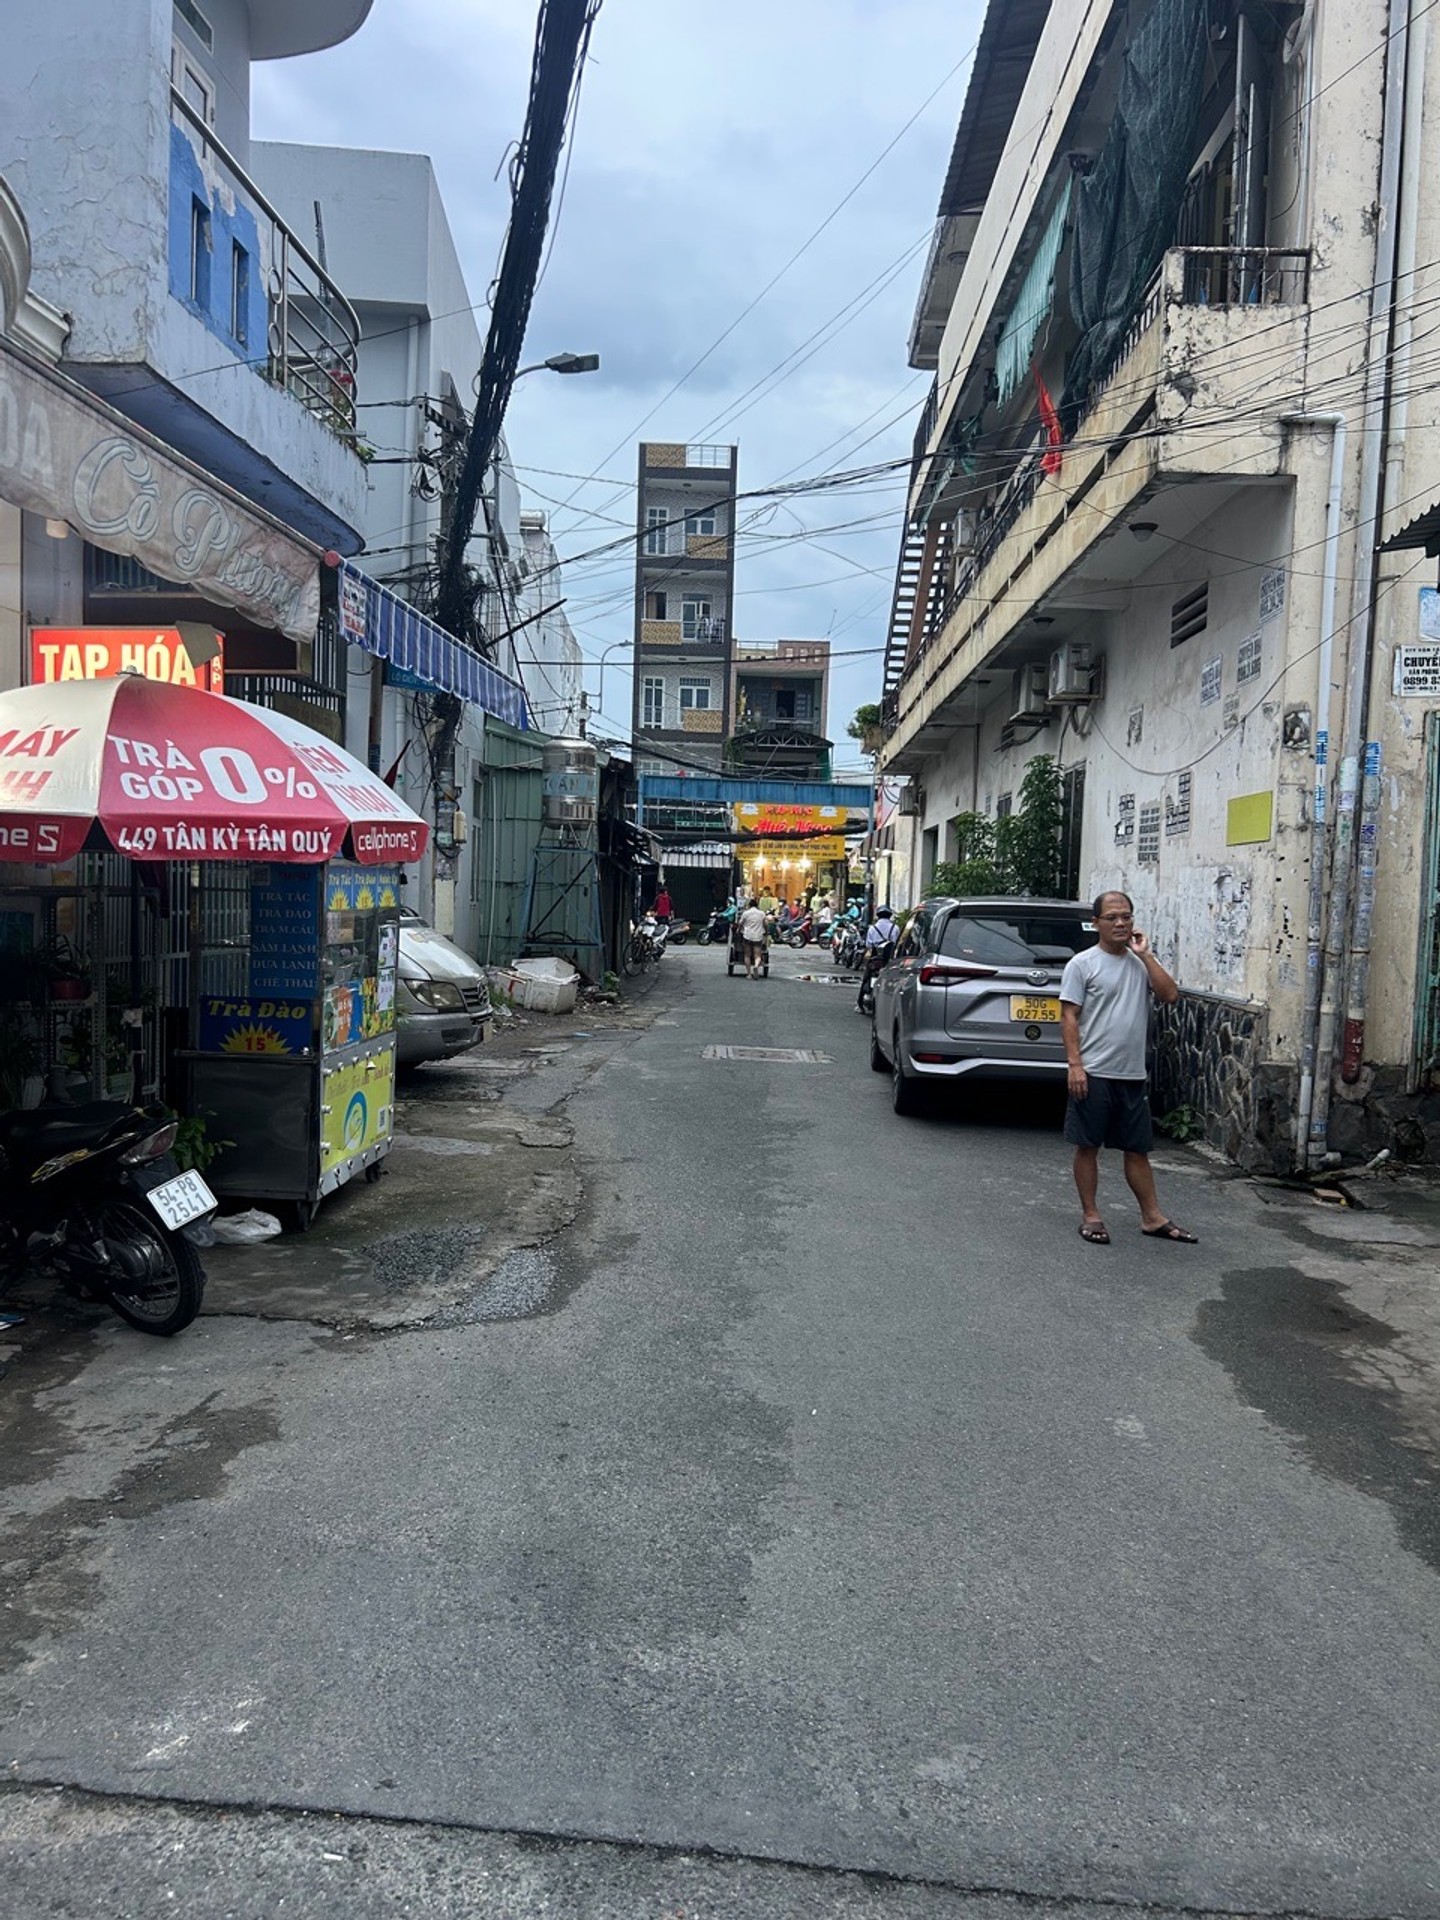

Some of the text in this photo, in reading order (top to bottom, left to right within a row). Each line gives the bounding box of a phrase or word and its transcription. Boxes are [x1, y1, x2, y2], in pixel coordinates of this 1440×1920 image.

[121, 635, 196, 685] HÓA
[120, 769, 204, 801] GÓP
[119, 821, 332, 854] 449 TÂN KỲ TÂN QUÝ
[208, 1000, 307, 1020] Trà Đào
[1016, 1009, 1056, 1021] 027.55
[1025, 998, 1047, 1009] 50G
[168, 1192, 208, 1224] 2541
